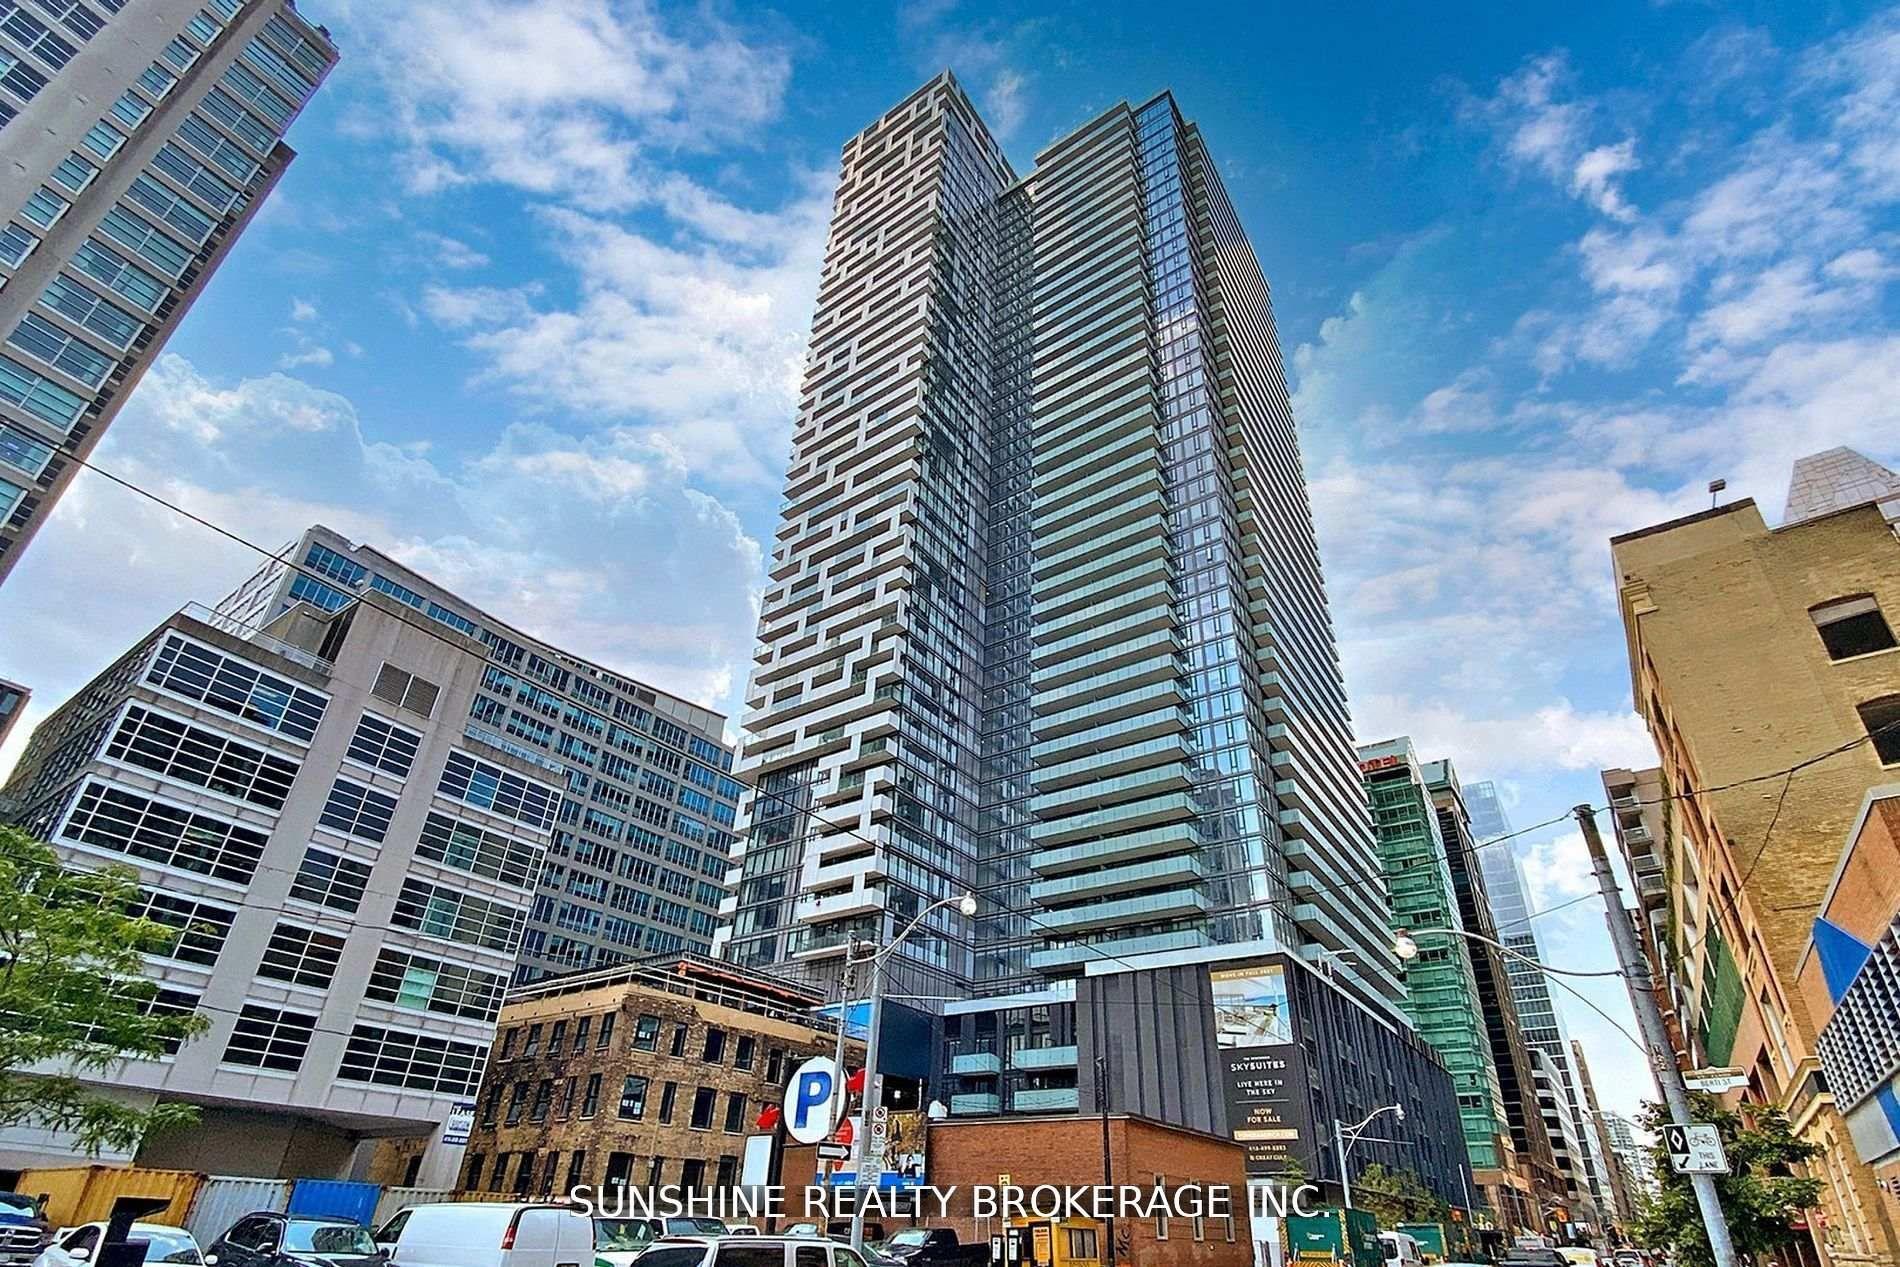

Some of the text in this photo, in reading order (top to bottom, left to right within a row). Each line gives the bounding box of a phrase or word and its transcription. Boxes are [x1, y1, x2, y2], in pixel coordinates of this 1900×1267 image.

[1230, 1060, 1286, 1072] SKYSUITES
[1236, 1080, 1252, 1088] LIVE
[1254, 1079, 1272, 1087] HERE
[1246, 1088, 1260, 1096] THE
[794, 1071, 832, 1128] P
[1247, 1115, 1281, 1124] FOR SALE
[1697, 1151, 1715, 1160] THIS
[1699, 1161, 1719, 1170] LANE
